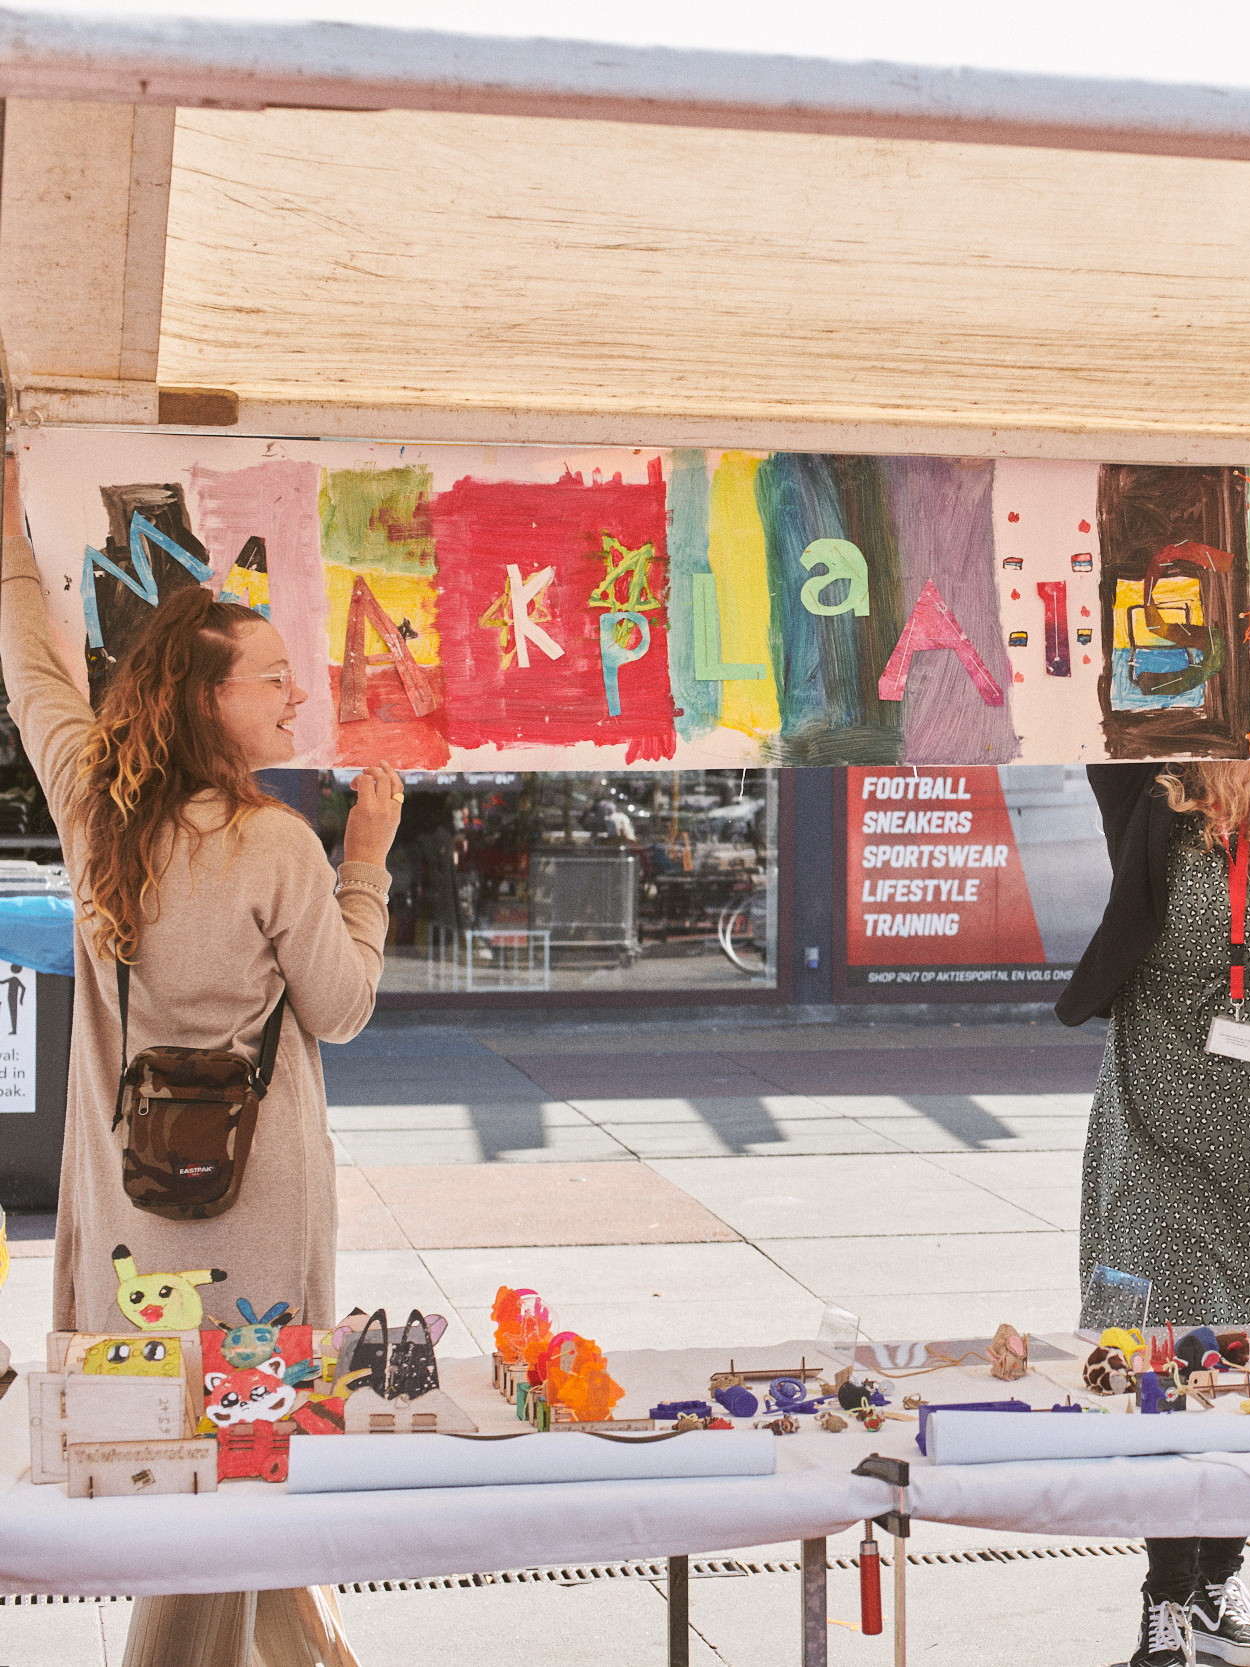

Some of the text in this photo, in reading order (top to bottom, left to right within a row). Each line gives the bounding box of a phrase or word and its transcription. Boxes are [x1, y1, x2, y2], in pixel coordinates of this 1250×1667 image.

[861, 776, 972, 800] FOOTBALL
[861, 811, 974, 834] SNEAKERS
[861, 845, 1009, 868] SPORTSWEAR
[861, 879, 981, 903] LIFESTYLE
[862, 913, 961, 937] TRAINING
[867, 972, 894, 983] SHOP
[920, 971, 936, 982] OP
[1010, 970, 1025, 981] EN
[1025, 970, 1052, 981] VOLG
[13, 1066, 26, 1079] in
[179, 1166, 214, 1175] EASTPAK
